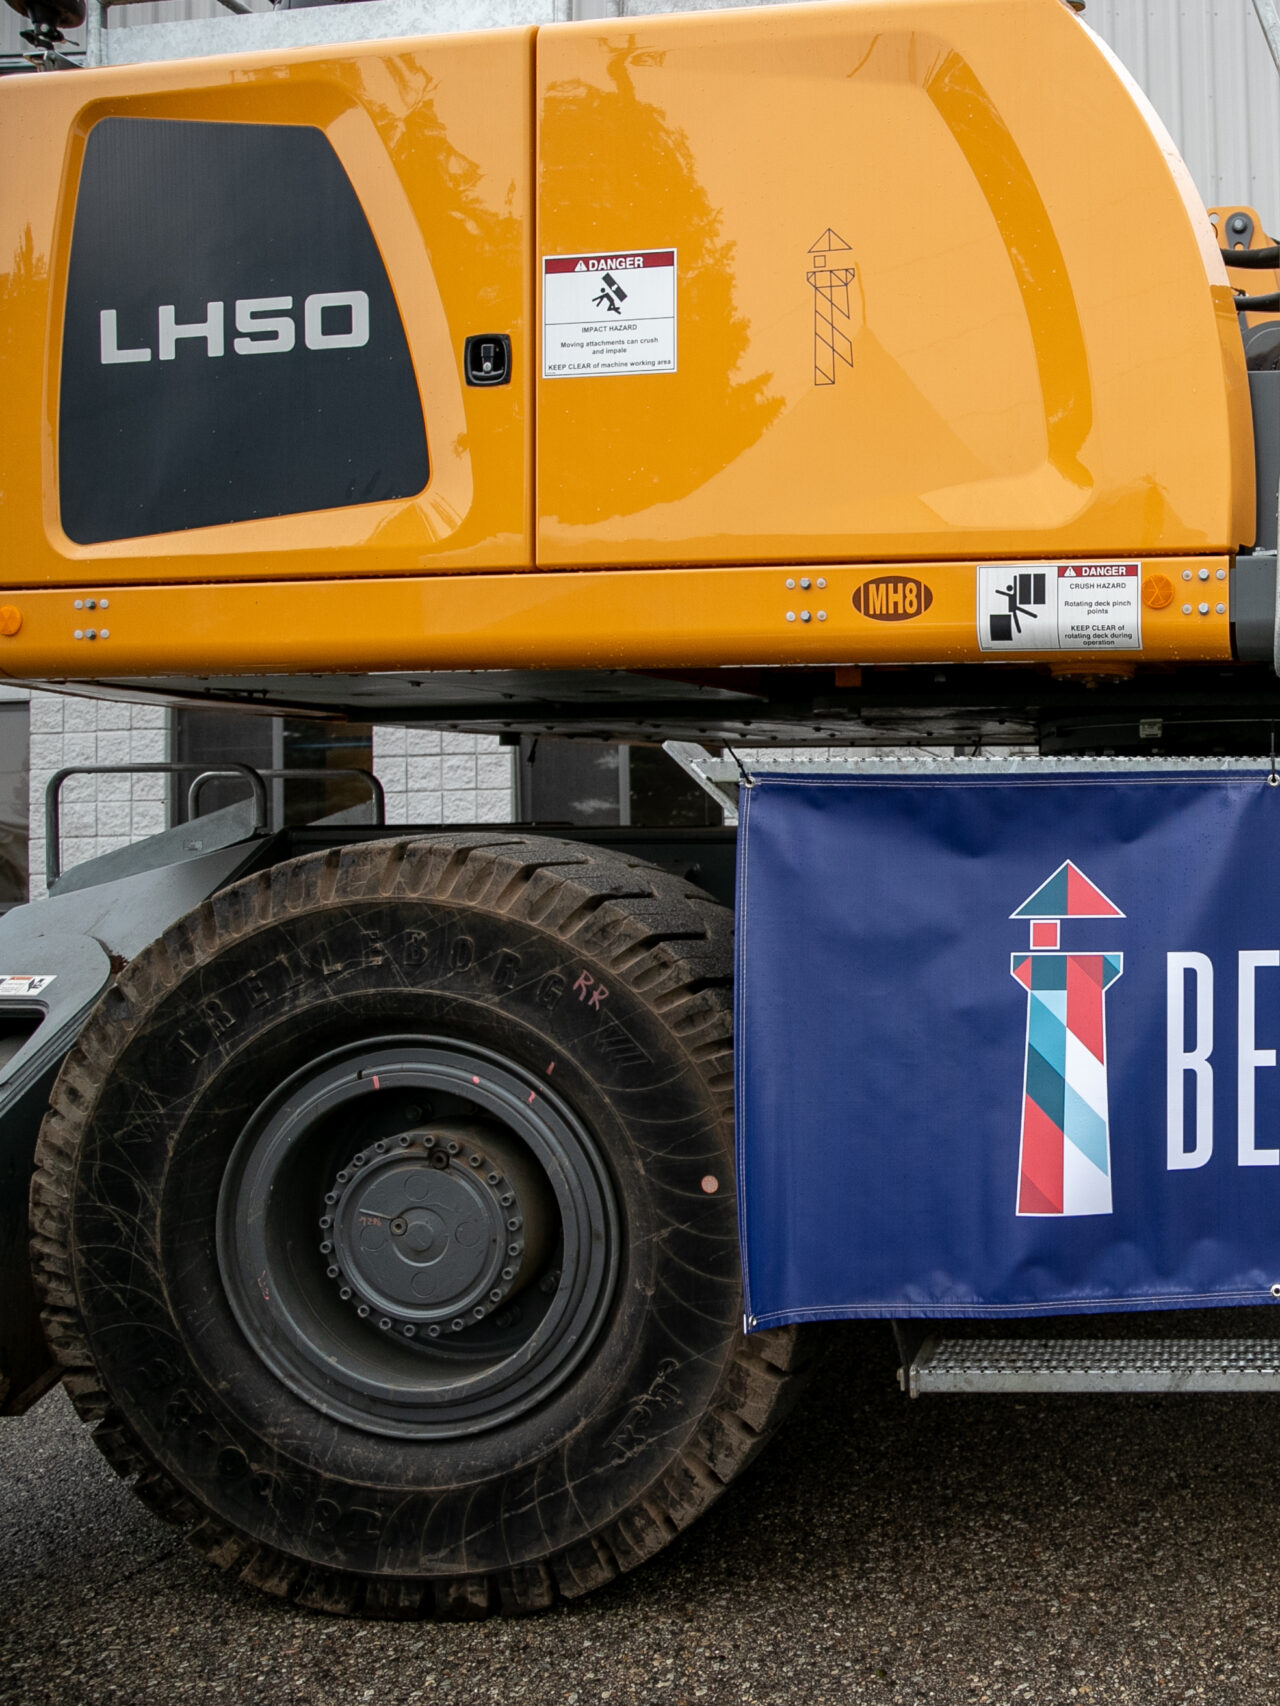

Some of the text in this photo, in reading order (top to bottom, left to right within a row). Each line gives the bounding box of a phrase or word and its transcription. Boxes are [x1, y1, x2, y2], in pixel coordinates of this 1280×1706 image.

[588, 256, 644, 271] DANGER
[100, 290, 370, 364] LH50
[581, 323, 638, 334] IMPACT HAZARD
[560, 341, 585, 349] Moving
[585, 339, 625, 348] attachments
[605, 347, 627, 356] impale
[629, 360, 656, 368] working
[1081, 566, 1127, 576] DANGER
[868, 582, 918, 615] MH8
[1064, 600, 1093, 608] Rotating
[1112, 599, 1132, 608] pinch
[1110, 632, 1133, 640] during
[572, 969, 610, 1012] RR
[175, 929, 566, 1063] TRELLEBORG
